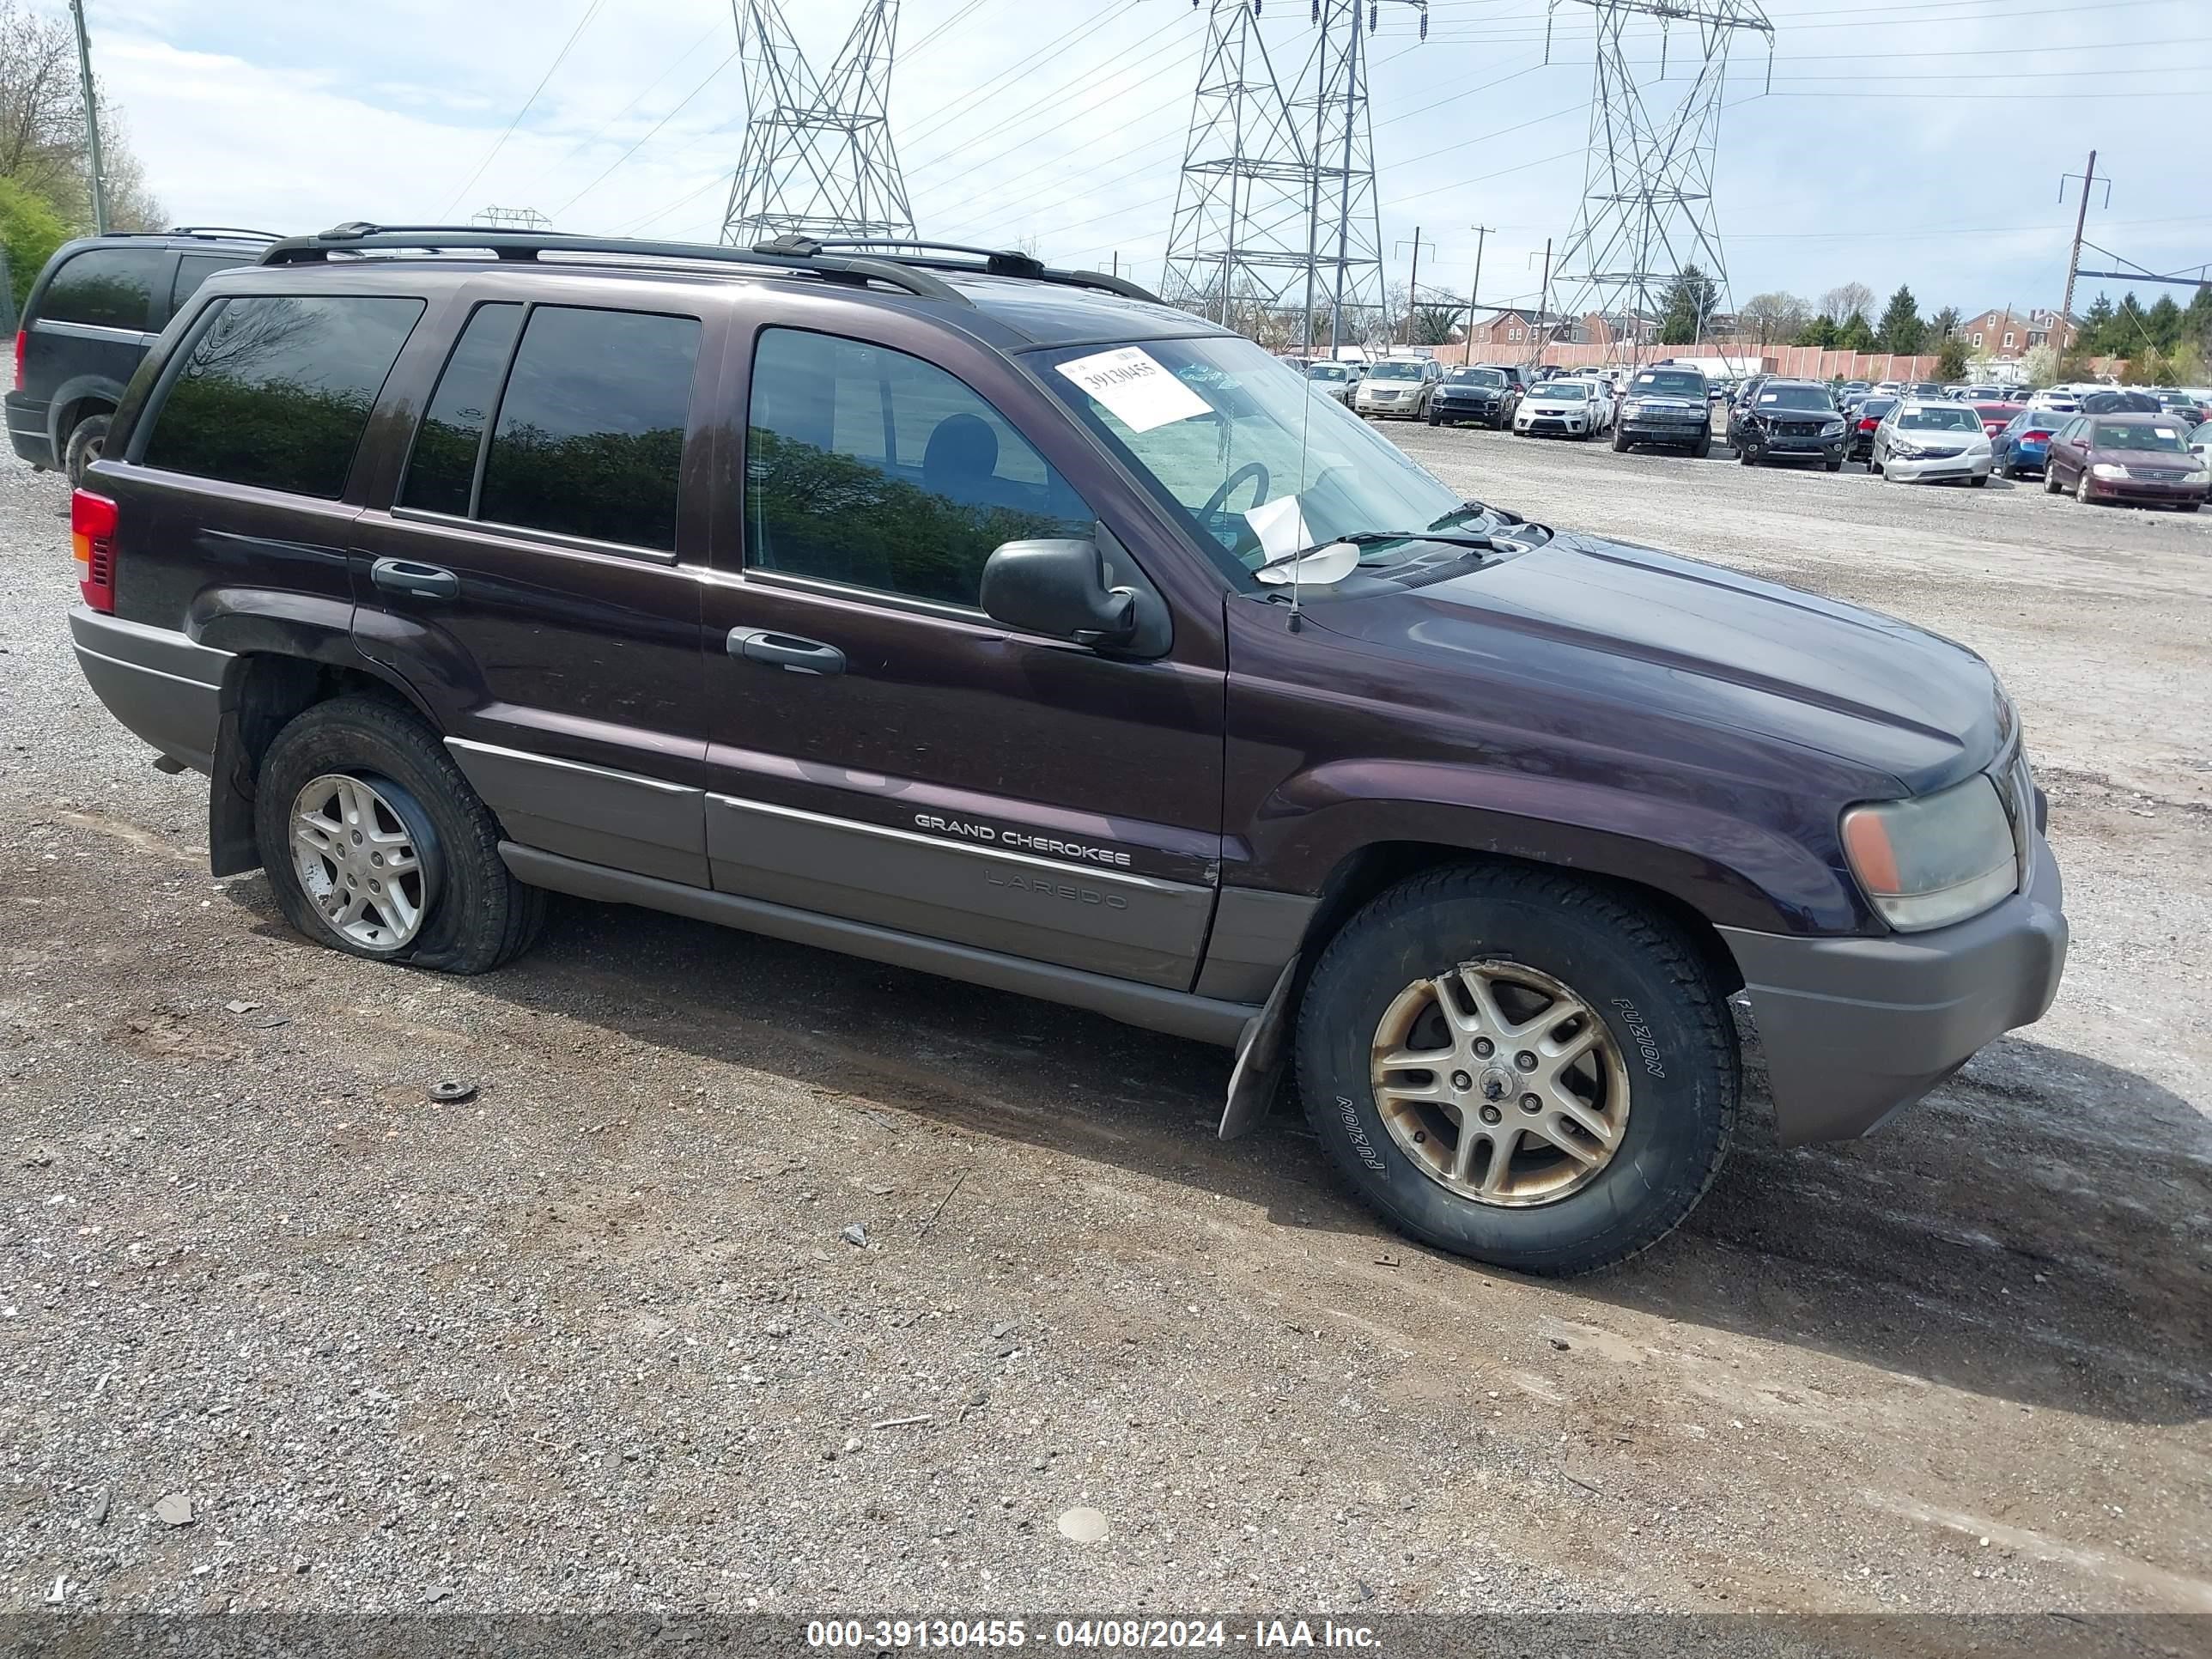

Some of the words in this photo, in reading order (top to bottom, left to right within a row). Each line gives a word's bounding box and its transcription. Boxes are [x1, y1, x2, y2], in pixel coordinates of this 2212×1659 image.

[1085, 362, 1156, 390] 39130455
[915, 814, 995, 840] GRAND
[1001, 831, 1131, 866] CHEROKEE
[984, 870, 1127, 909] LAREDO
[1611, 999, 1665, 1079] FUZION
[1336, 1096, 1386, 1170] FUZION
